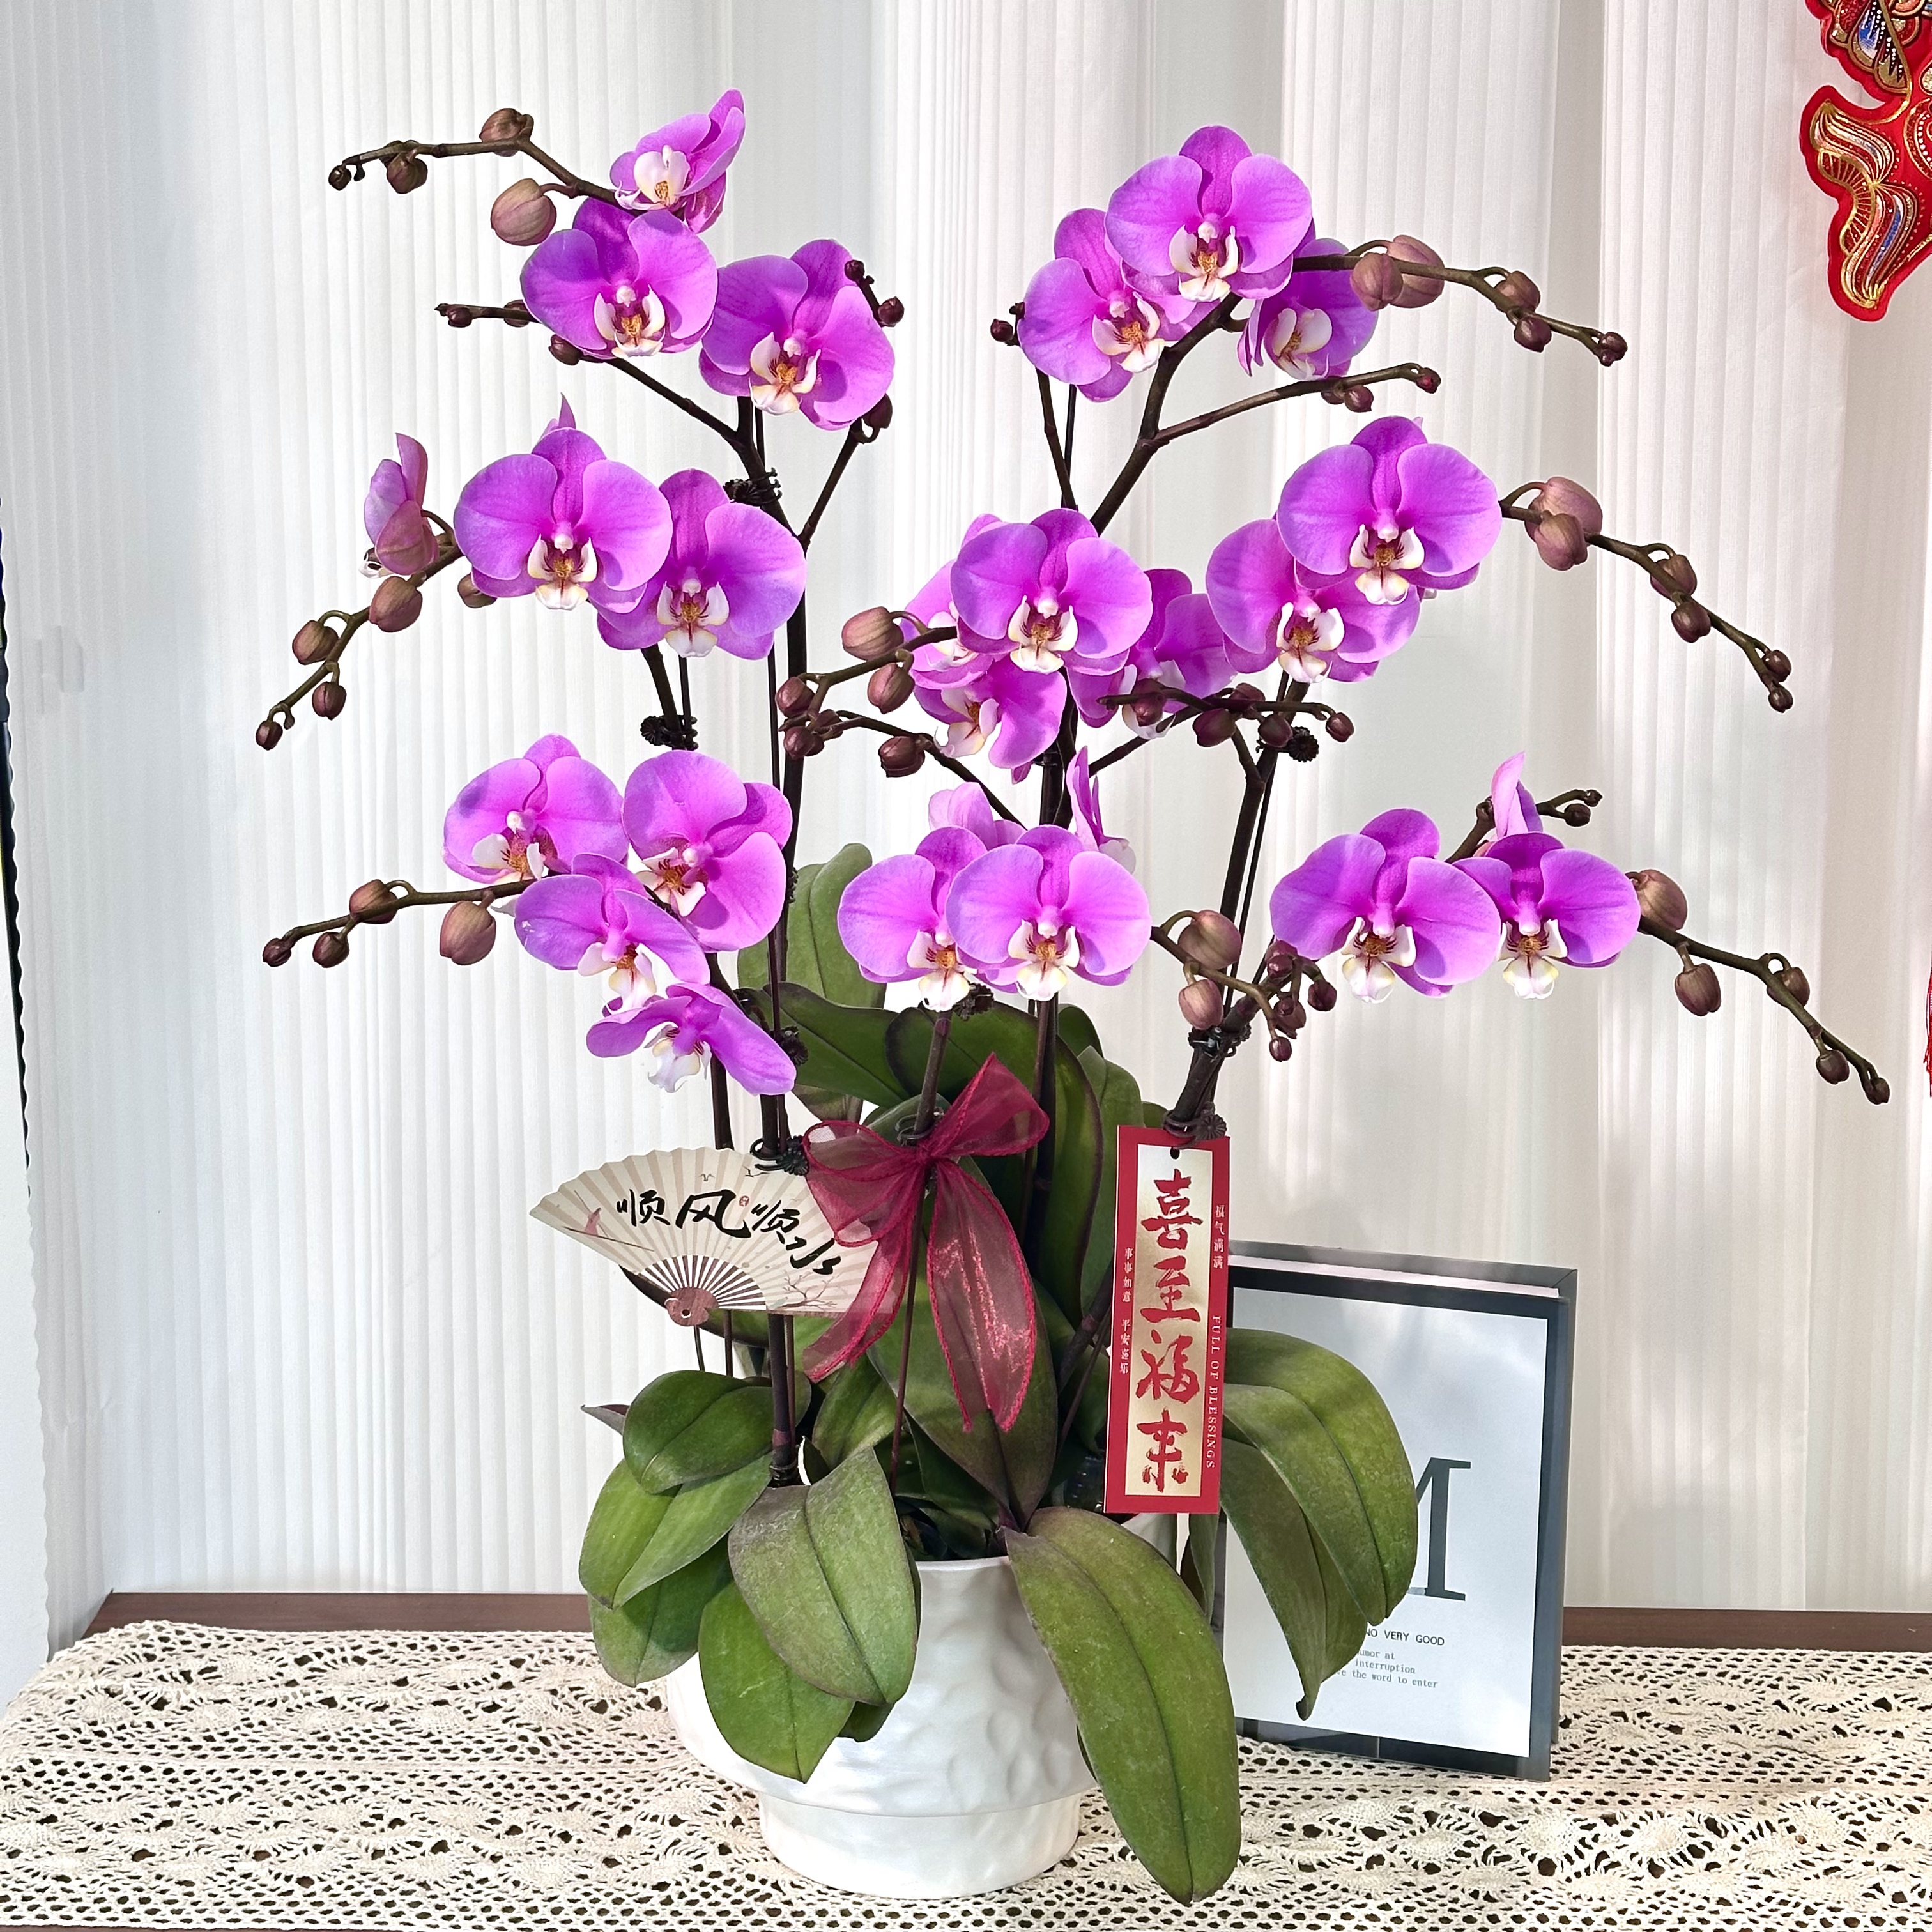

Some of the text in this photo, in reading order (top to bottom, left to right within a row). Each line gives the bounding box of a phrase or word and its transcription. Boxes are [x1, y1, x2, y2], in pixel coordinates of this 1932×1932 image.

[616, 1189, 841, 1274] 顺风顺水
[1213, 1204, 1225, 1269] 福气满满
[1122, 1247, 1134, 1303] 事事如意
[1136, 1169, 1204, 1493] 喜至福来
[1206, 1315, 1221, 1469] FULL OF BLESSINGS
[1355, 1658, 1416, 1674] interruption
[1384, 1630, 1410, 1642] VERY
[1416, 1634, 1445, 1646] GOOD
[1384, 1652, 1395, 1660] at
[1353, 1669, 1367, 1679] the
[1372, 1674, 1392, 1683] word
[1412, 1679, 1438, 1688] enter
